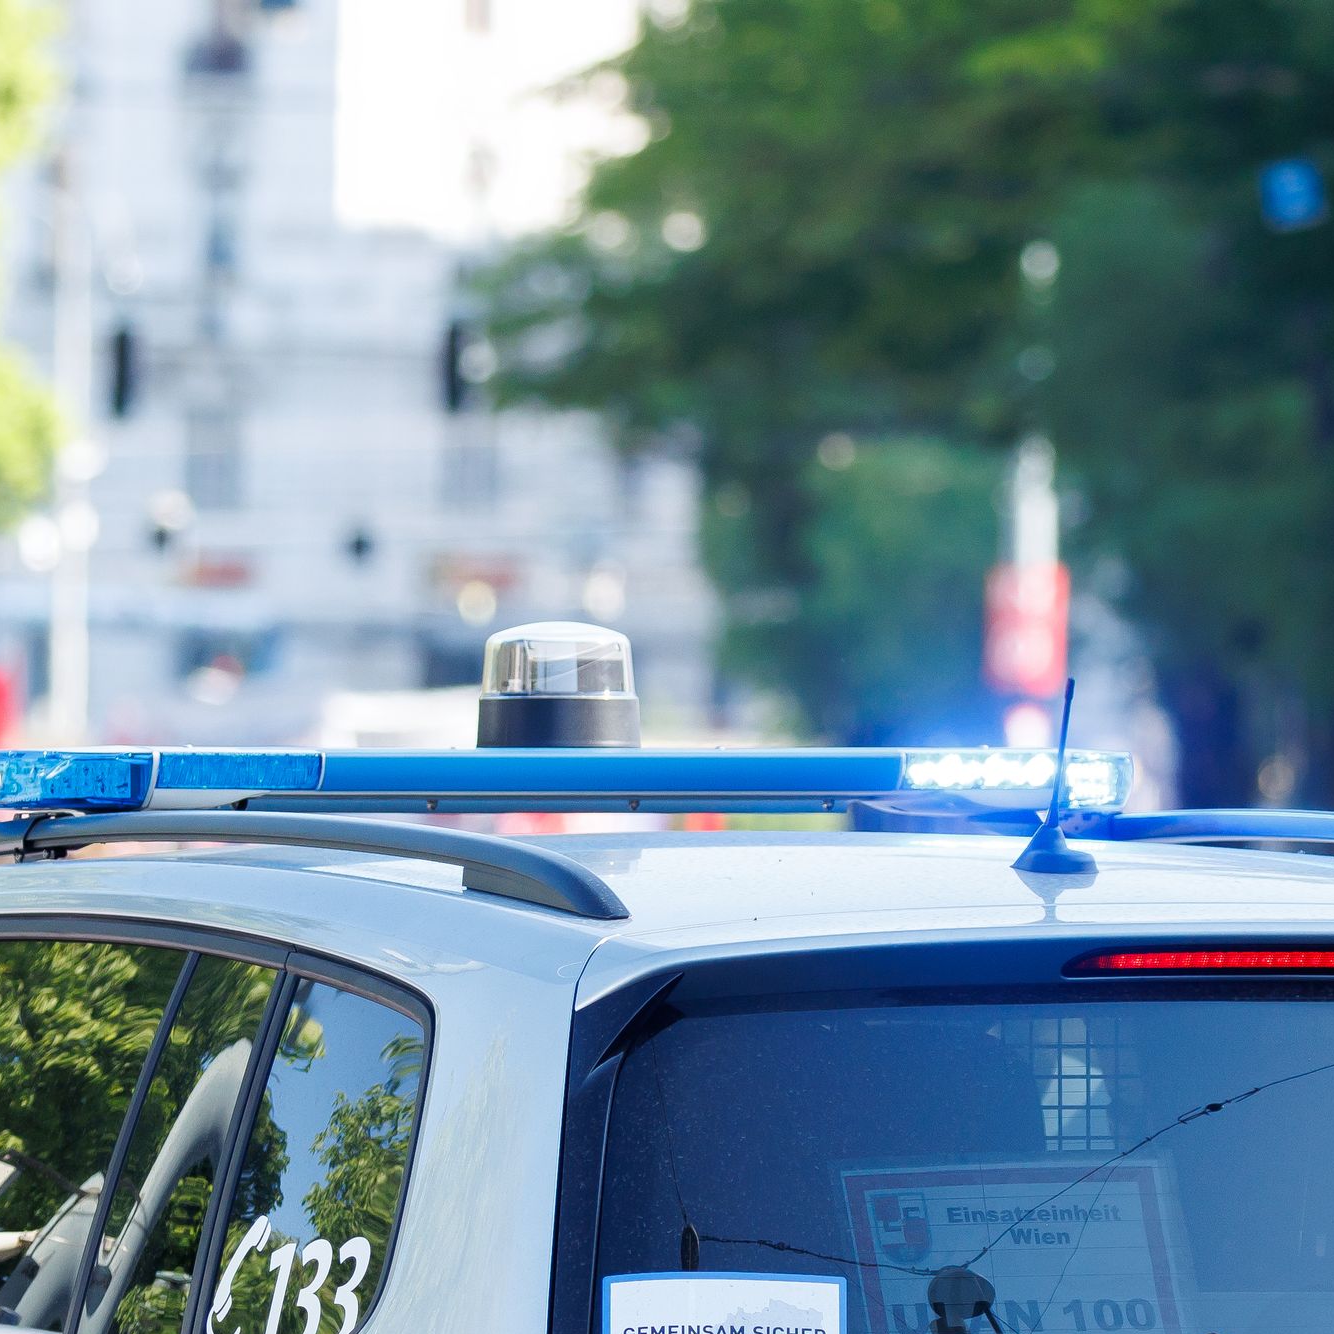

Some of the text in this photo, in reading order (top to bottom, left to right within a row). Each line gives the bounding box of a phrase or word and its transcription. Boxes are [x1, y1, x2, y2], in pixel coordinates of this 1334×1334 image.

[946, 1204, 1123, 1224] Einsatzeinheit
[1010, 1227, 1072, 1246] Wien
[1063, 1297, 1157, 1333] 100
